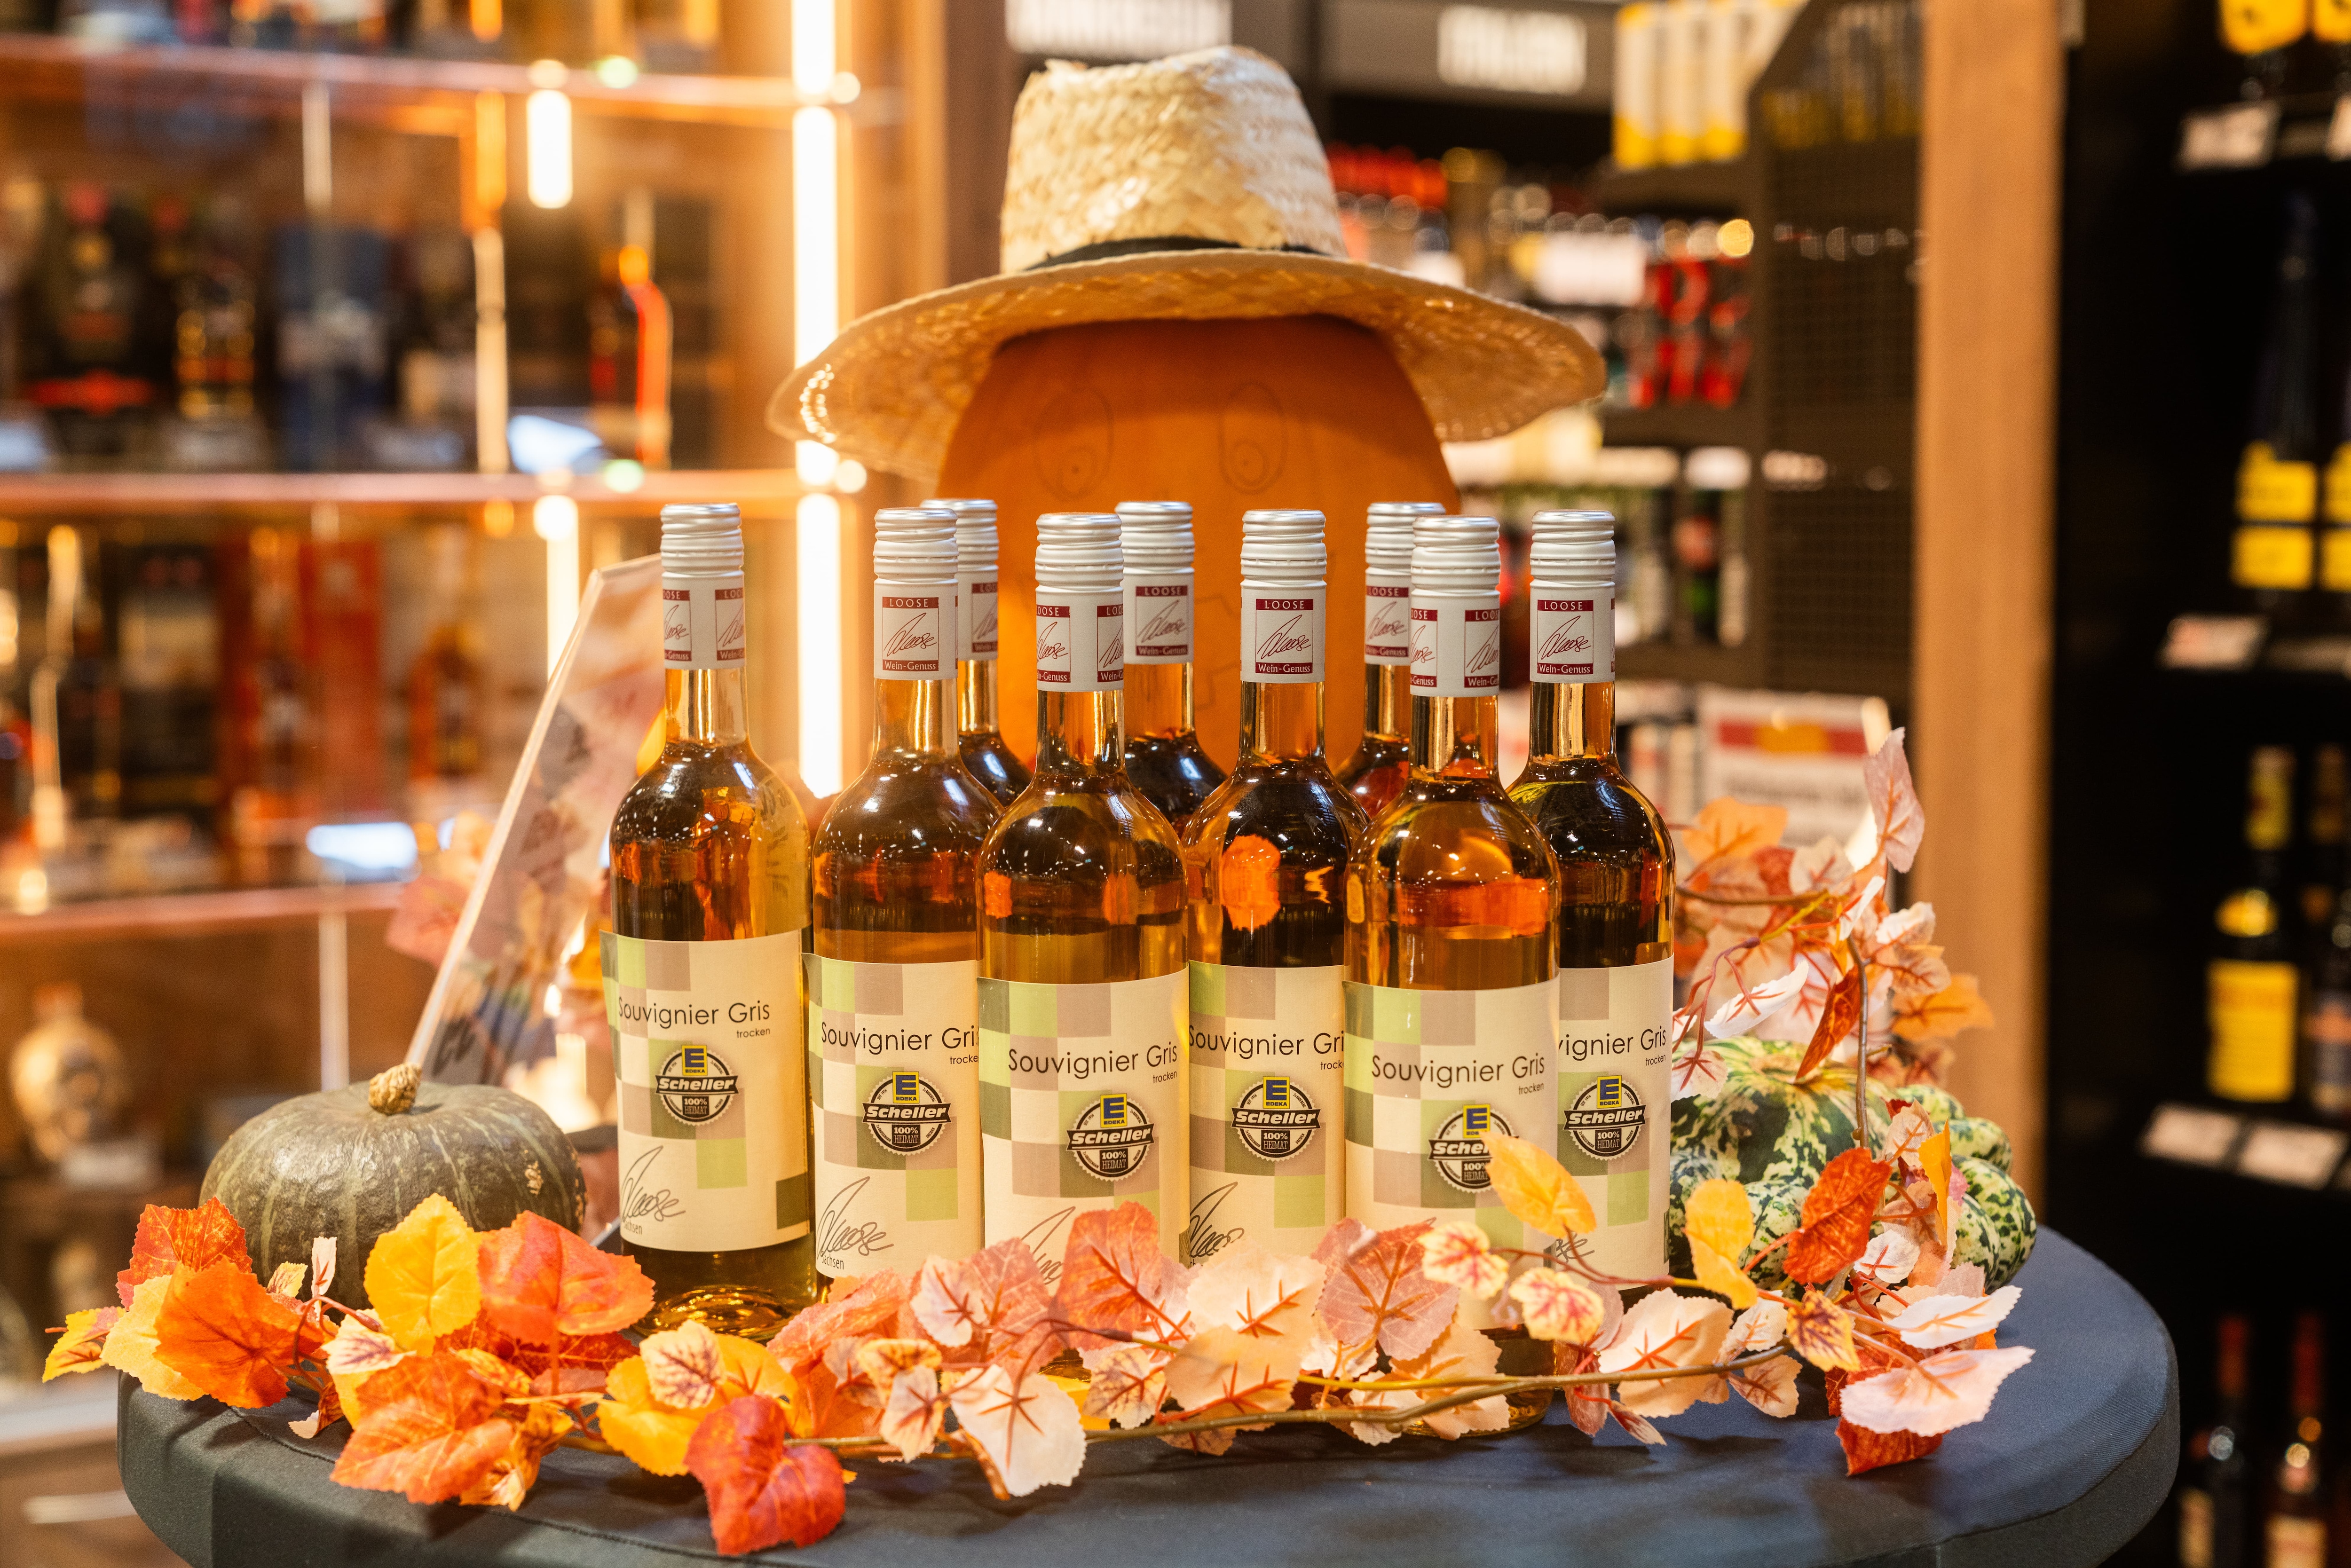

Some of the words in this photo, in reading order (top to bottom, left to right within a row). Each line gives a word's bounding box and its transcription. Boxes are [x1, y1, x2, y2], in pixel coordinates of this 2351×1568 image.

[724, 589, 742, 599] LOO
[1144, 587, 1182, 596] LOOSE
[890, 599, 929, 607] LOOSE
[1265, 600, 1304, 609] LOOSE
[1545, 601, 1583, 610] LOOSE
[1036, 607, 1059, 616] OOSE
[1107, 606, 1123, 615] LOO
[1475, 610, 1499, 620] LOOS
[720, 650, 743, 659] Wein-G
[1138, 646, 1186, 655] Wein-Genuss
[885, 661, 936, 670] Wein-Genuss
[1258, 664, 1310, 673] Wein-Genuss
[1539, 664, 1590, 673] Wein-Genuss
[1411, 676, 1434, 686] -Genuss
[619, 996, 719, 1029] Souvignier
[728, 1000, 770, 1023] Gris
[737, 1028, 770, 1038] trocken
[821, 1021, 932, 1055] Souvignier
[1641, 1025, 1666, 1050] Gris
[1189, 1024, 1304, 1060] Souvignier
[1314, 1030, 1344, 1054] Gri
[685, 1048, 704, 1067] E
[950, 1055, 978, 1064] trocke
[1009, 1048, 1138, 1079] Souvignier
[1146, 1041, 1177, 1067] Gris
[1646, 1054, 1666, 1066] trocken
[1320, 1060, 1344, 1070] trock
[1372, 1055, 1504, 1088] Souvignier
[1512, 1053, 1544, 1079] Gris
[1153, 1071, 1177, 1083] trocken
[659, 1078, 734, 1091] Scheller
[896, 1075, 916, 1095] E
[1266, 1079, 1287, 1100] E
[1519, 1082, 1544, 1095] trocken
[1600, 1078, 1619, 1100] E
[684, 1105, 708, 1115] HEIMAT
[867, 1106, 947, 1119] Scheller
[1104, 1097, 1124, 1119] E
[1235, 1111, 1316, 1124] Scheller
[1467, 1108, 1487, 1129] E
[1568, 1110, 1643, 1124] Scheller
[894, 1135, 918, 1143] HEIMAT
[1071, 1128, 1151, 1144] Scheller
[1263, 1140, 1288, 1150] HEIMAT
[1433, 1142, 1490, 1155] Schel
[1597, 1139, 1620, 1149] HEIMAT
[1102, 1151, 1126, 1159] 100%
[1102, 1159, 1127, 1169] HEIMAT
[821, 1251, 844, 1270] Sachsen
